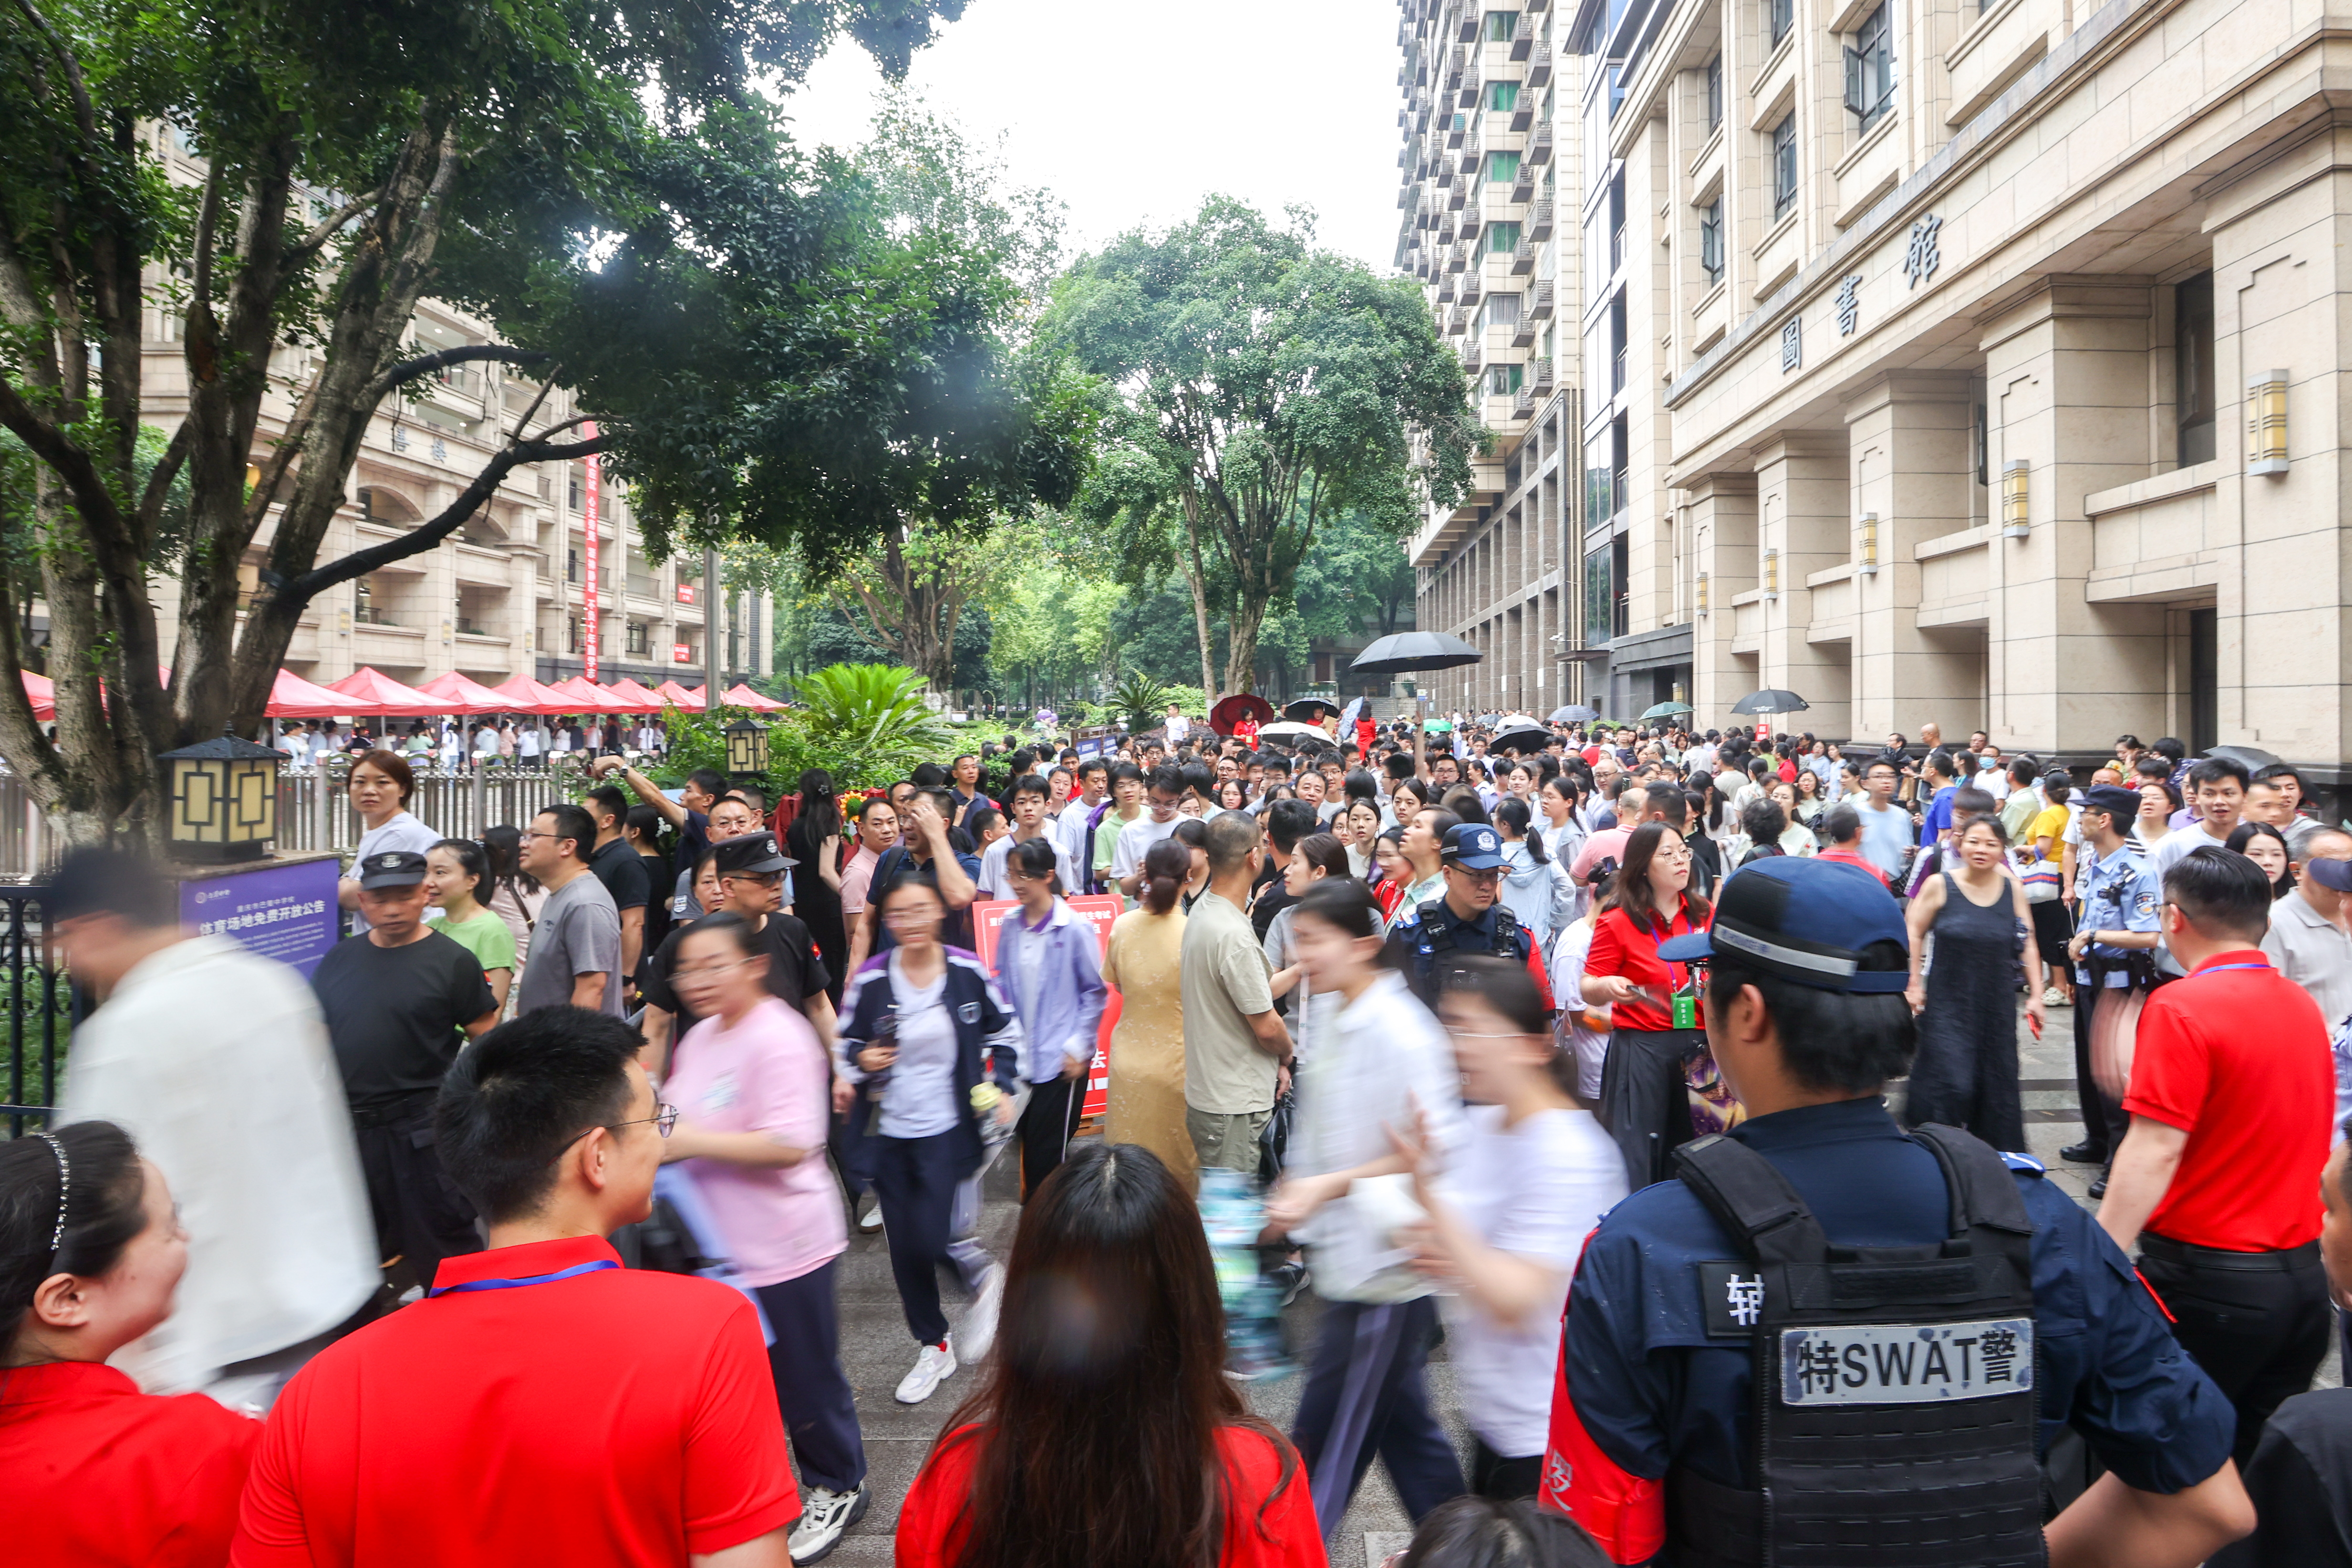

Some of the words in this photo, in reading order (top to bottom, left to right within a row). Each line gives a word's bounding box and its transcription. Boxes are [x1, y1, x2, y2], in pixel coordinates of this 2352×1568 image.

[1782, 213, 1943, 375] 圖書館
[199, 900, 326, 935] 体育场地免费开放公告
